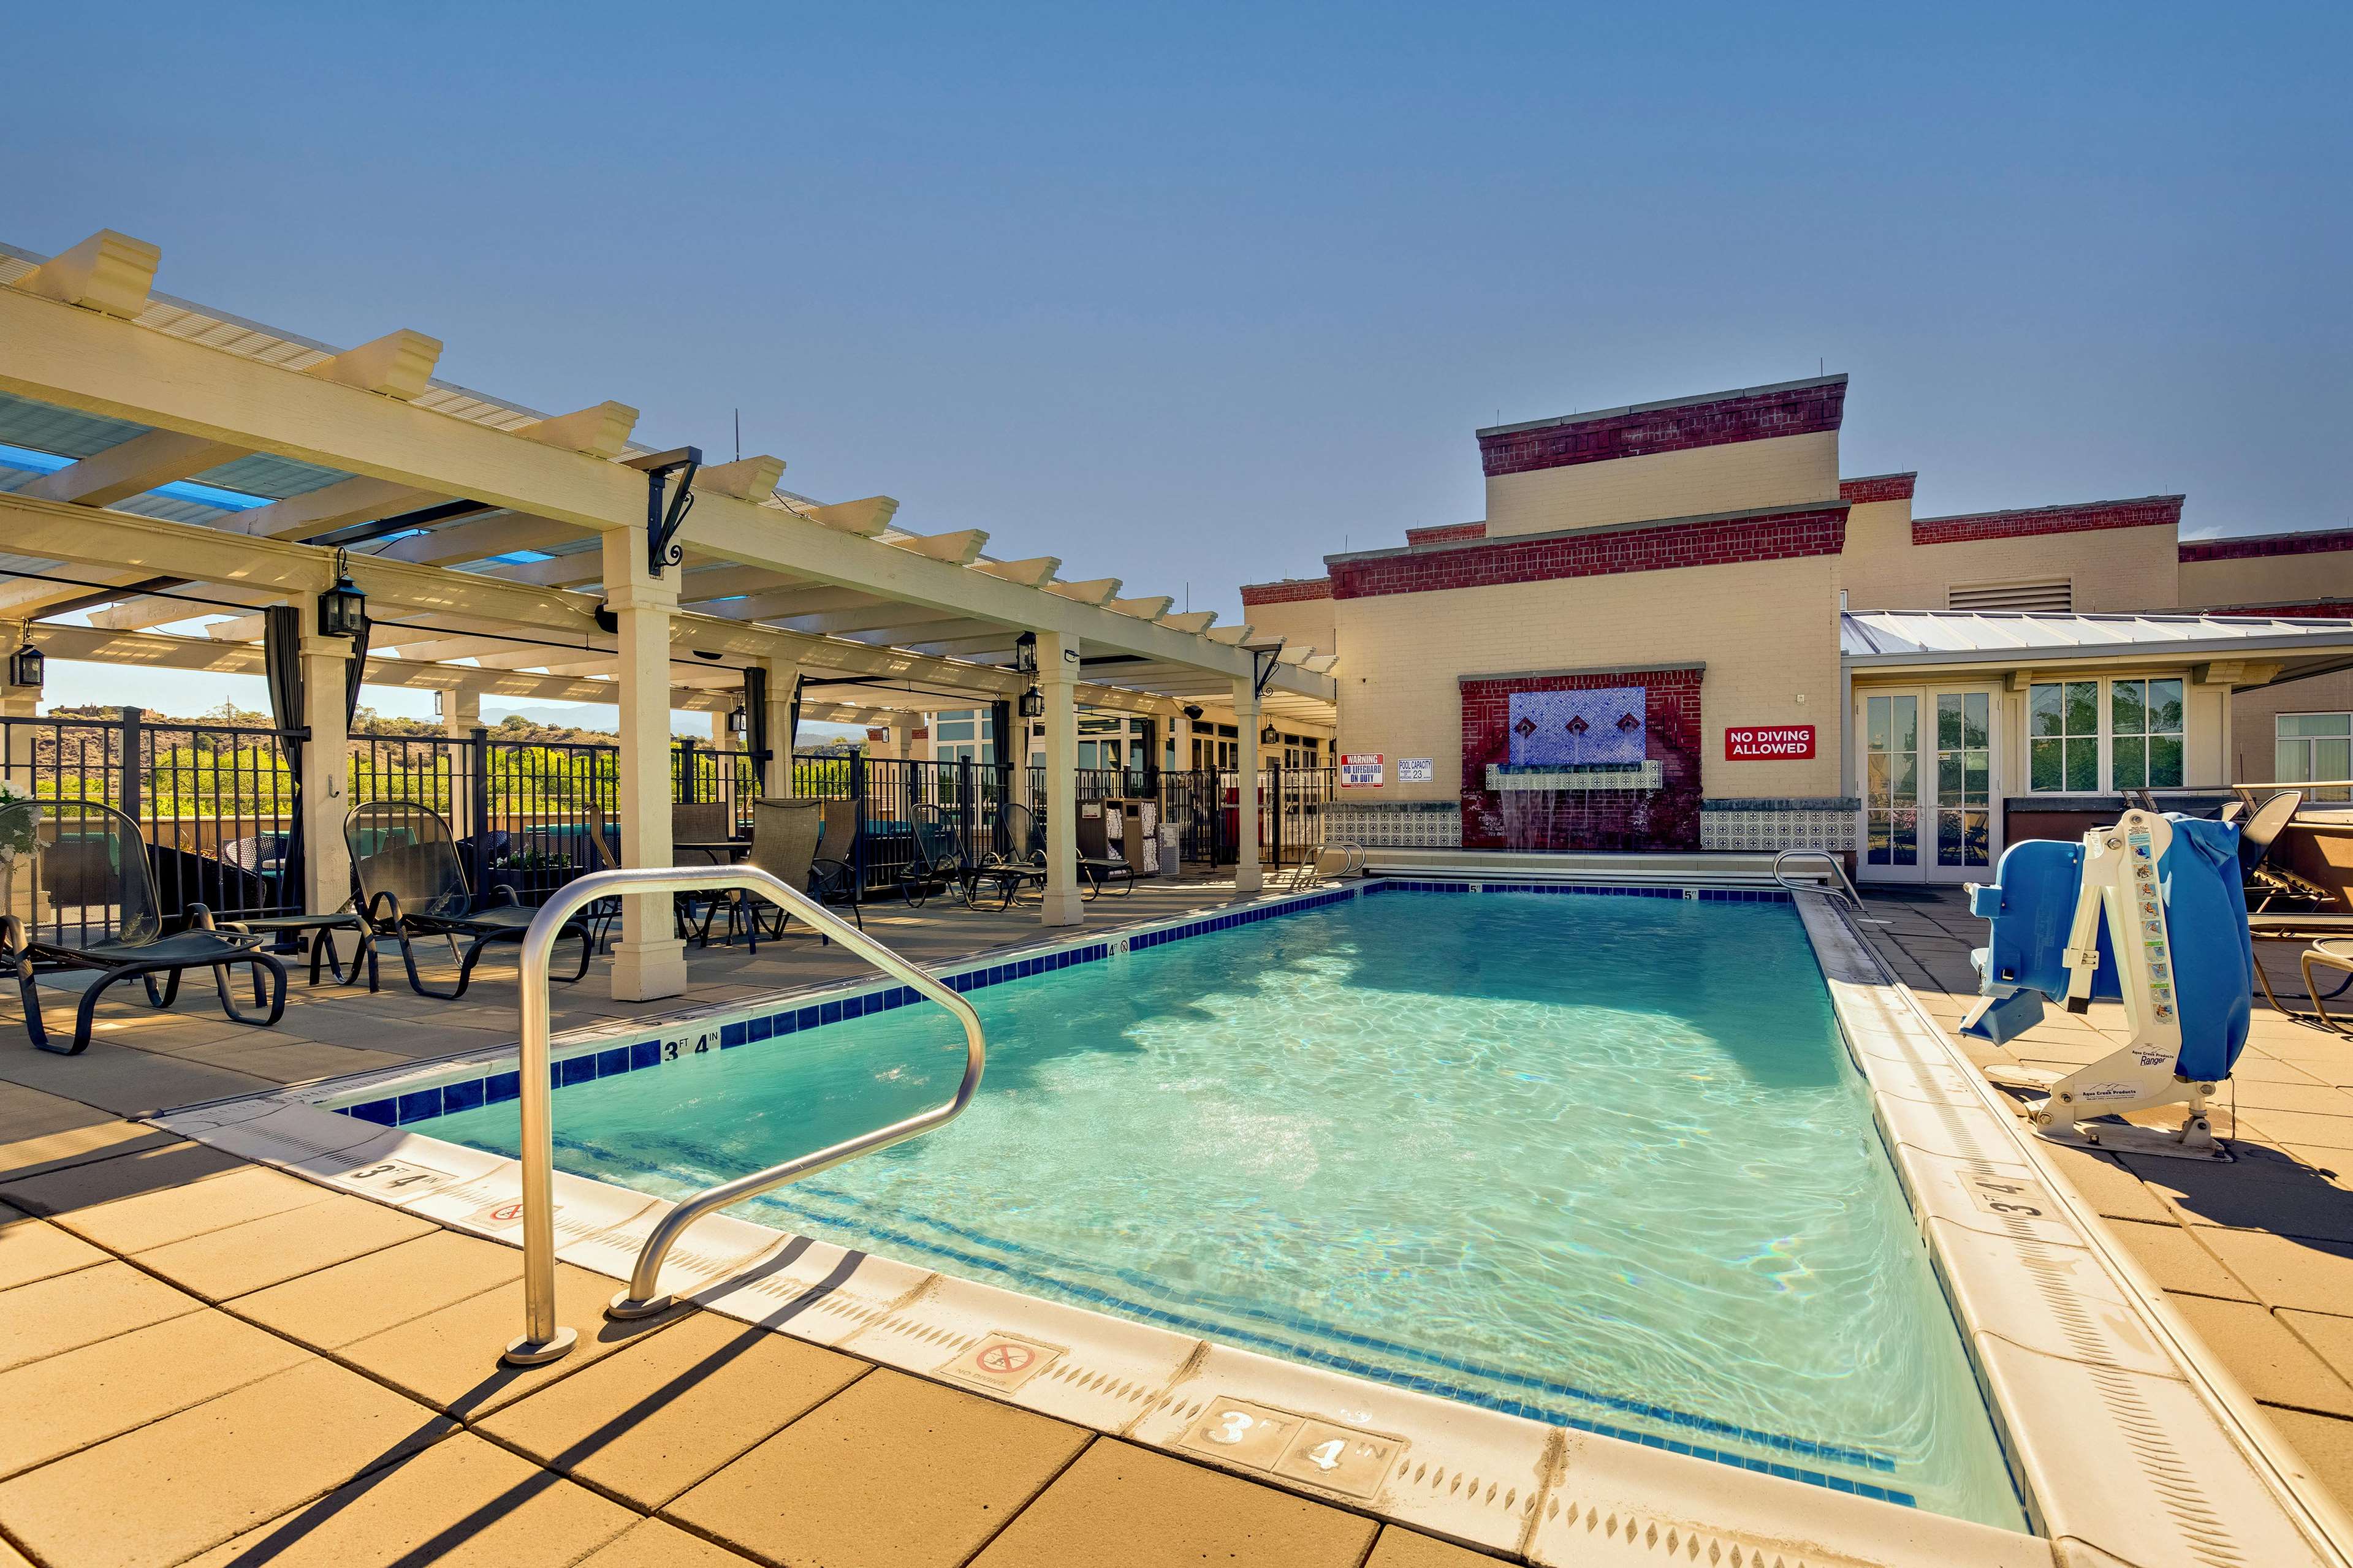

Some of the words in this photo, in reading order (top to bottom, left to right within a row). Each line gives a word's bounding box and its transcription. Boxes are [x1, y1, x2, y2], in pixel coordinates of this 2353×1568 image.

[1731, 732, 1753, 743] NO
[1758, 730, 1809, 742] DIVING
[1733, 744, 1808, 755] ALLOWED
[1347, 755, 1378, 764] WARNING
[1400, 761, 1411, 770] POOL
[1412, 760, 1431, 769] CAPACITY
[1344, 765, 1351, 774] NO
[1353, 765, 1382, 774] LIFEGUARD
[1413, 770, 1422, 779] 23
[1350, 774, 1358, 782] ON
[1360, 774, 1374, 782] DUTY
[1109, 944, 1114, 956] 4
[664, 1041, 679, 1061] 3
[679, 1038, 689, 1048] FT
[694, 1034, 709, 1054] 4
[709, 1031, 718, 1041] IN
[2140, 1056, 2165, 1066] Ranger
[351, 1165, 396, 1178] 3
[387, 1175, 430, 1188] 4
[1975, 1182, 2024, 1194] 4
[1990, 1203, 2042, 1216] 3
[972, 1373, 1006, 1386] DIVING
[1199, 1410, 1254, 1445] 3
[1296, 1437, 1351, 1476] 4
[1355, 1441, 1388, 1460] IN
